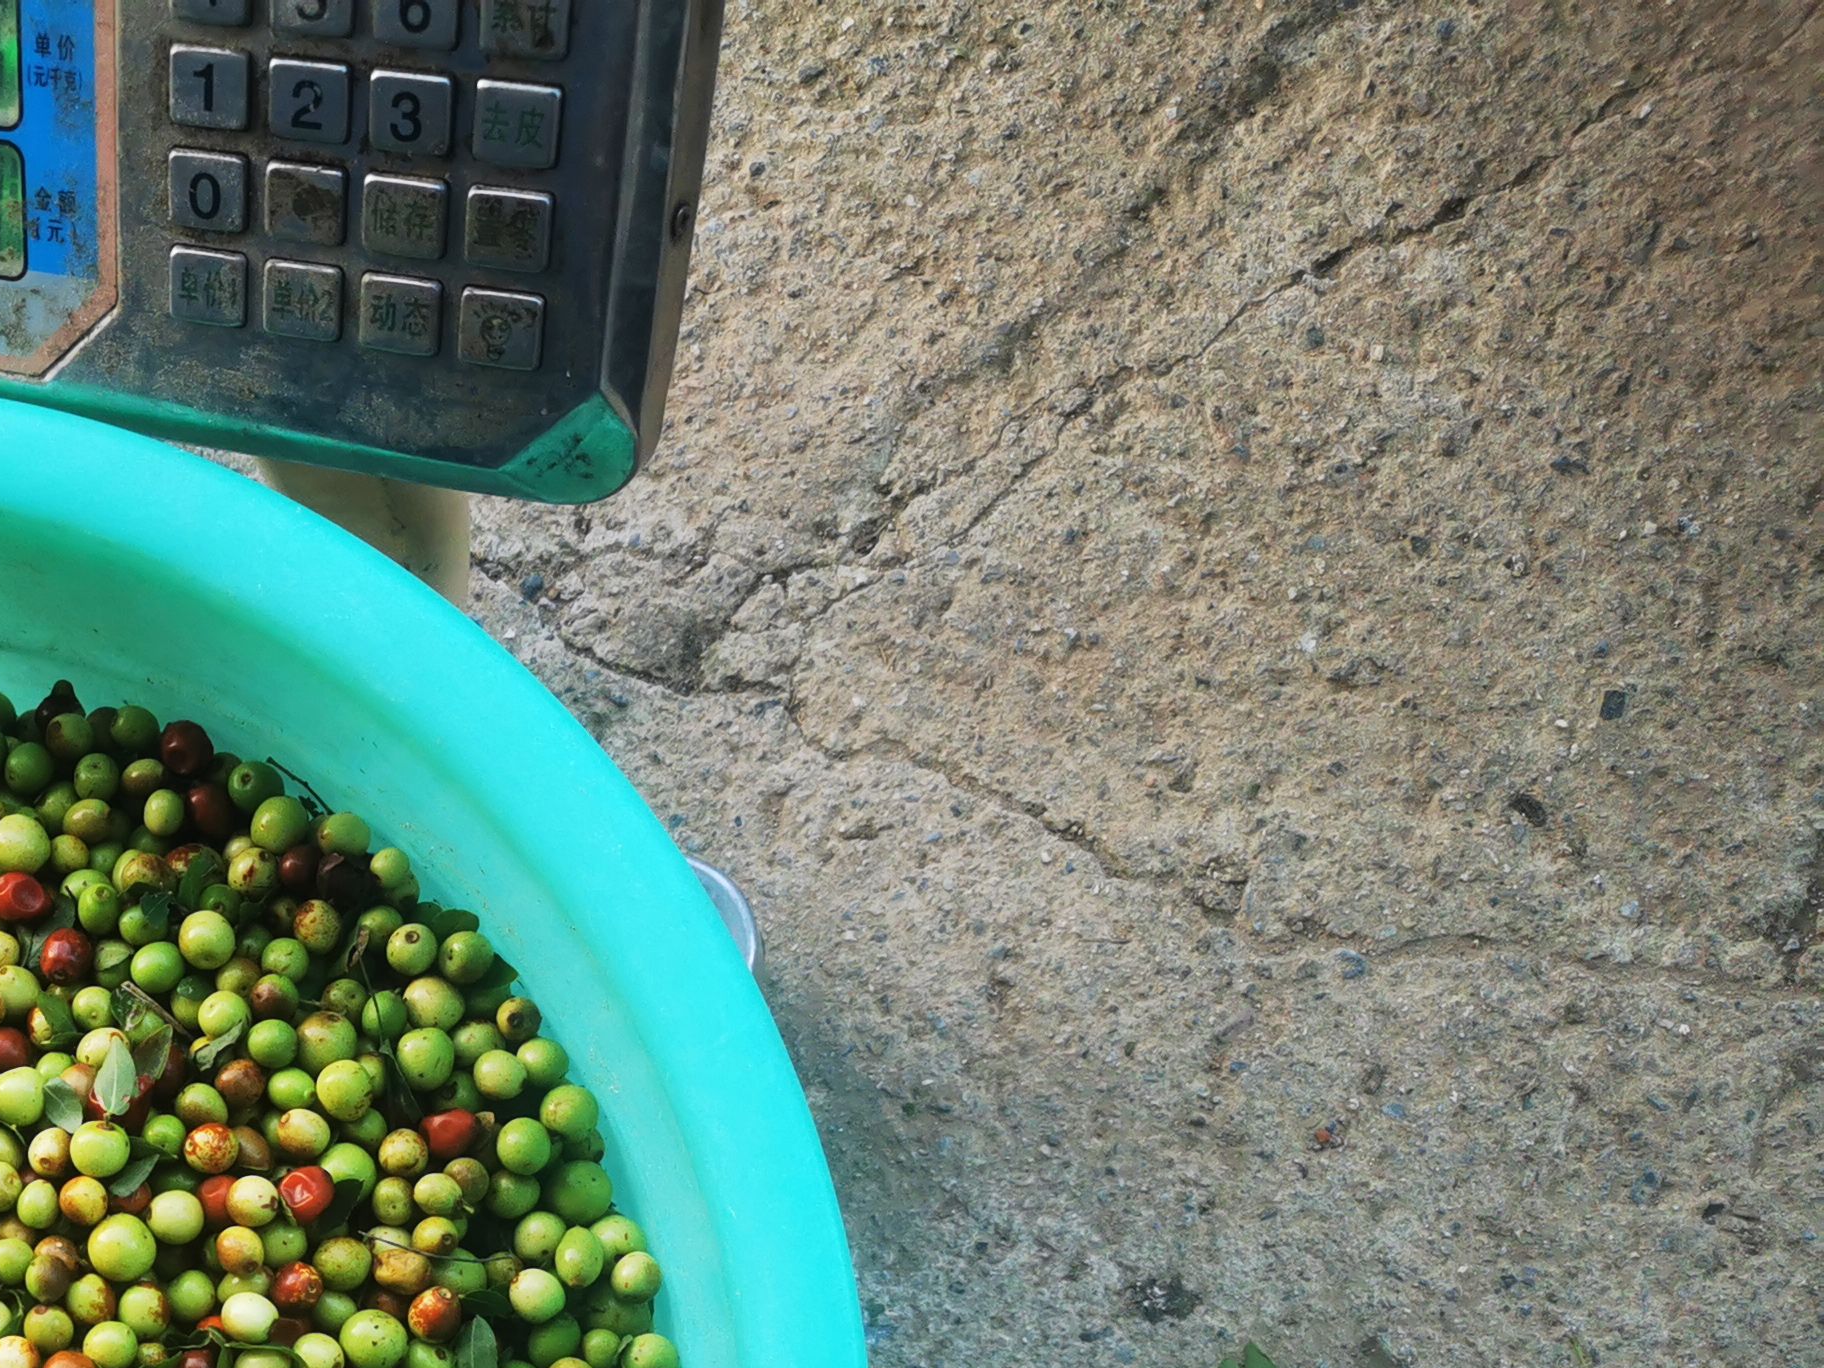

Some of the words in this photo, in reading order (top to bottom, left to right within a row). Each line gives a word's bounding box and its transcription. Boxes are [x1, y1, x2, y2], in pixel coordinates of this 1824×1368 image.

[34, 31, 75, 61] 单价
[193, 63, 214, 112] 1
[291, 80, 323, 130] 2
[389, 91, 422, 142] 3
[481, 101, 546, 149] 去皮
[188, 171, 221, 221] 0
